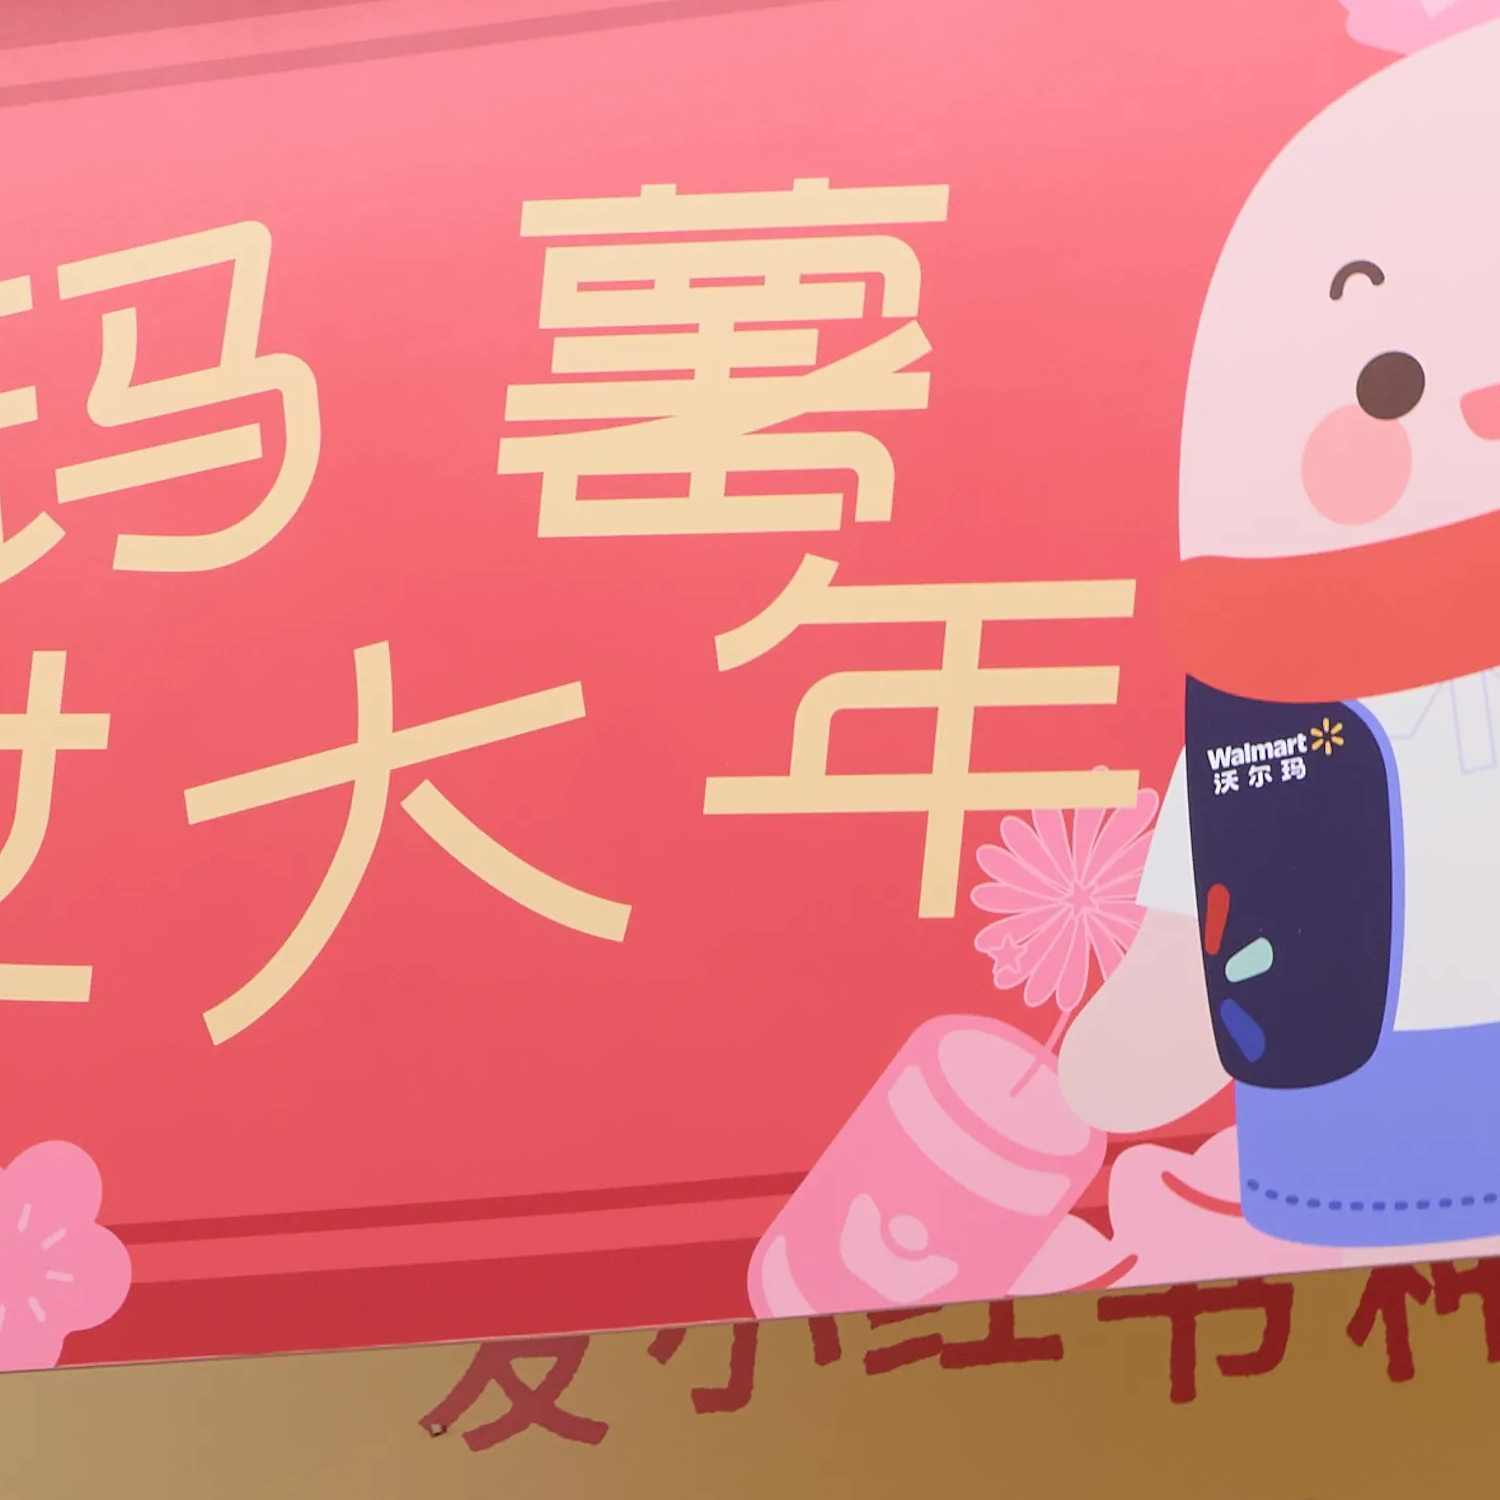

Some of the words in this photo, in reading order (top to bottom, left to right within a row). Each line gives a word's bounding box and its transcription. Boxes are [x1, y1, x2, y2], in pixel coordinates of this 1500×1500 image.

[1206, 733, 1308, 771] Walmart
[1213, 756, 1307, 795] 沃尔玛
